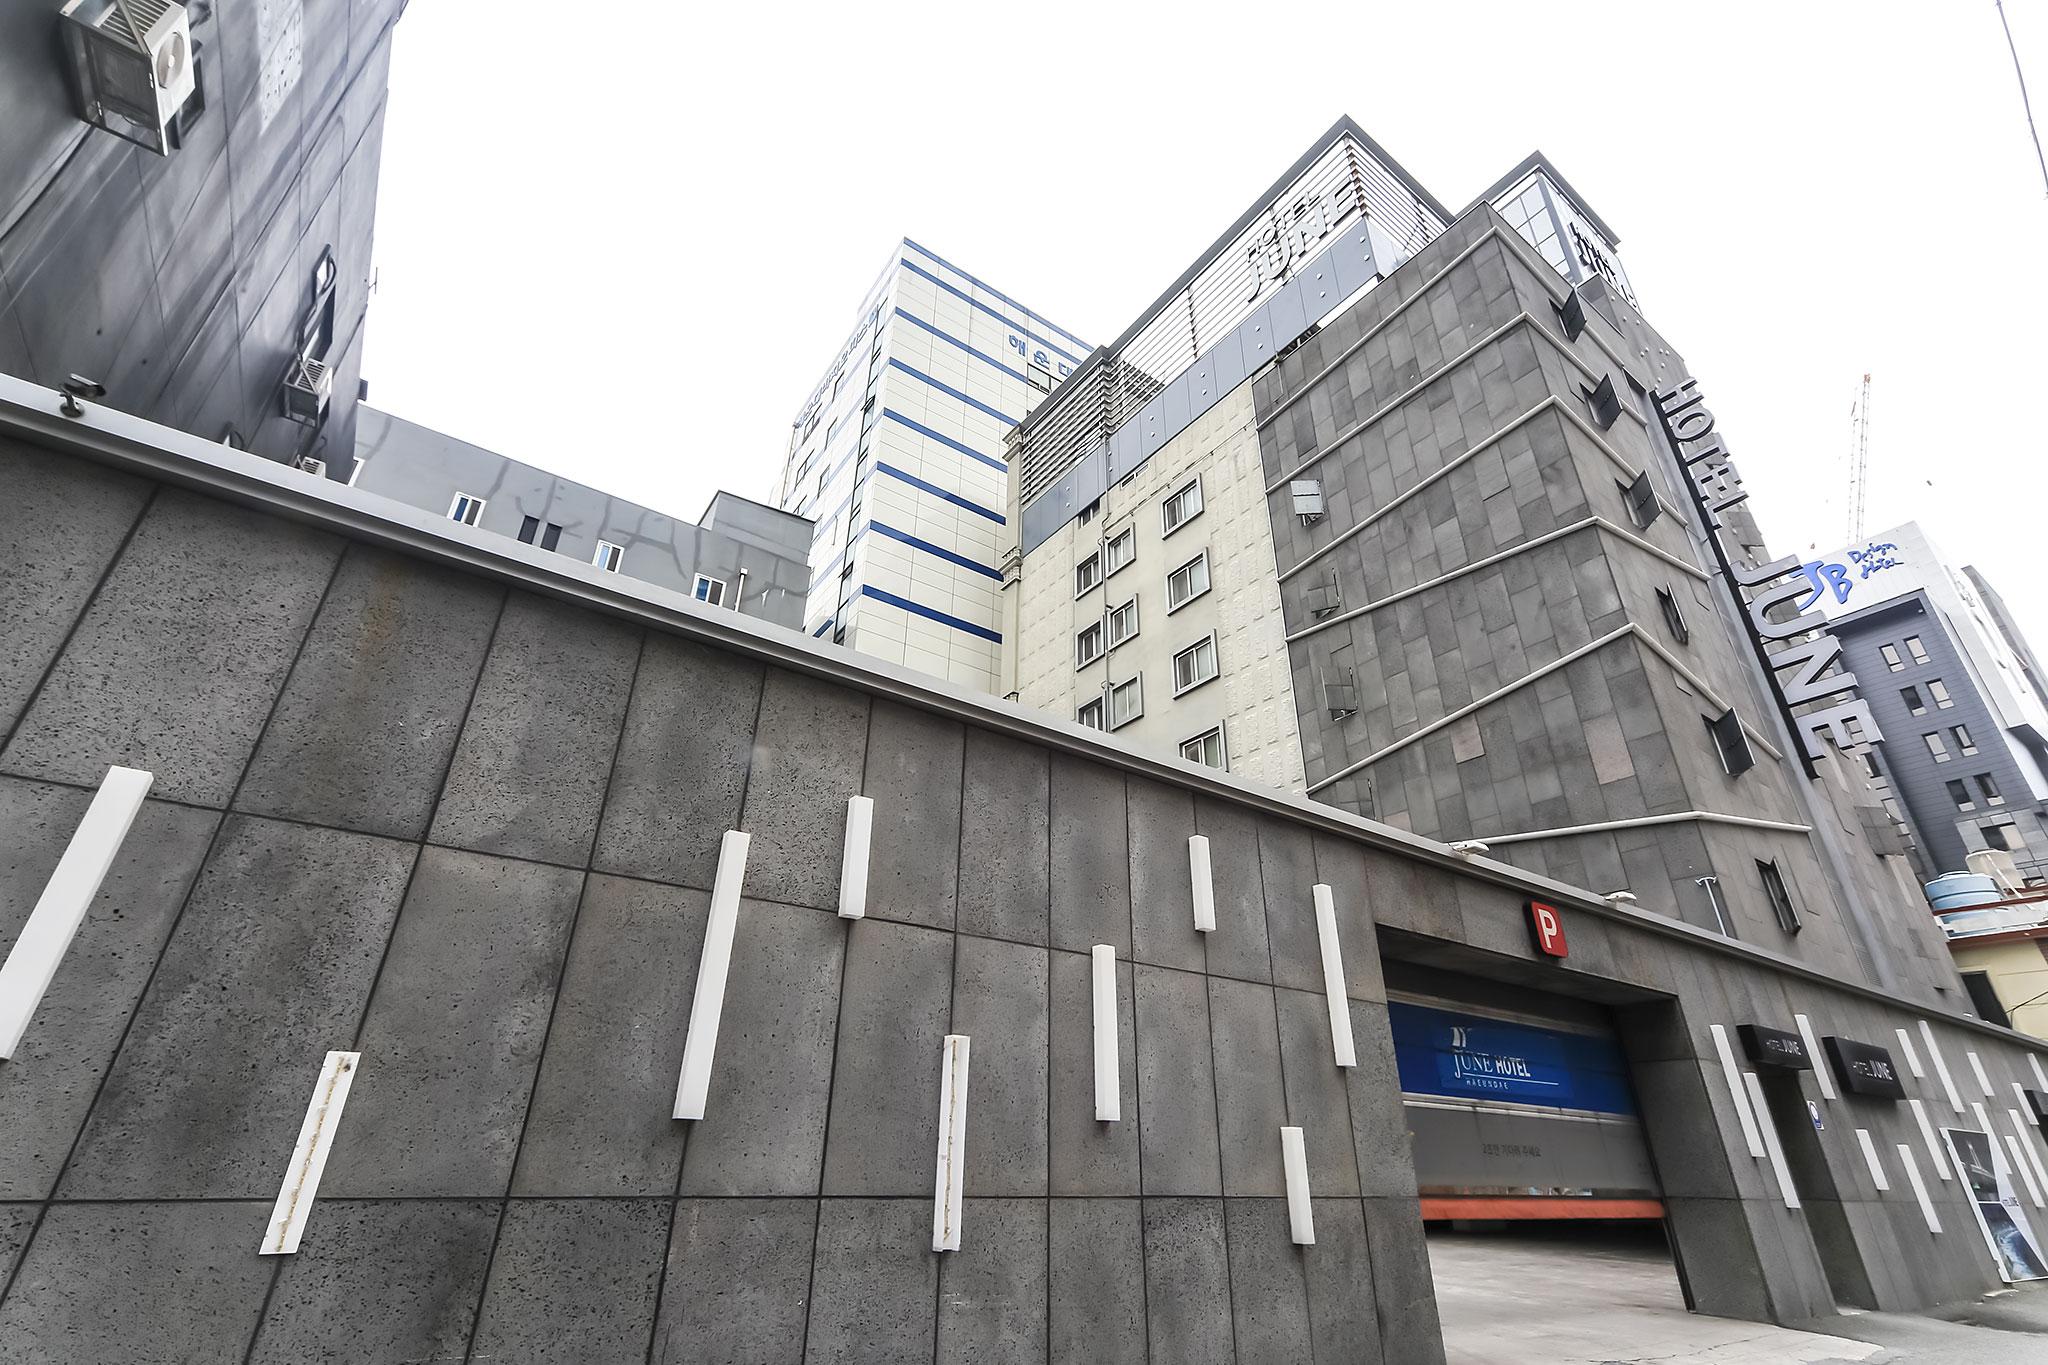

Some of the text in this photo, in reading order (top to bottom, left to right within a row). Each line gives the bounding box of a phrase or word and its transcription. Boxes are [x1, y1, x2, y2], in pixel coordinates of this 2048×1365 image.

[1246, 190, 1321, 264] HOTEL
[1248, 180, 1361, 303] JUNE
[1655, 376, 1749, 530] HOTEL
[1847, 542, 1898, 564] Design
[1789, 560, 1853, 612] JB
[1730, 553, 1885, 760] JUNE
[1538, 908, 1558, 949] P
[1454, 1049, 1531, 1079] JUNE HOTEL
[1869, 1059, 1893, 1081] JUNE
